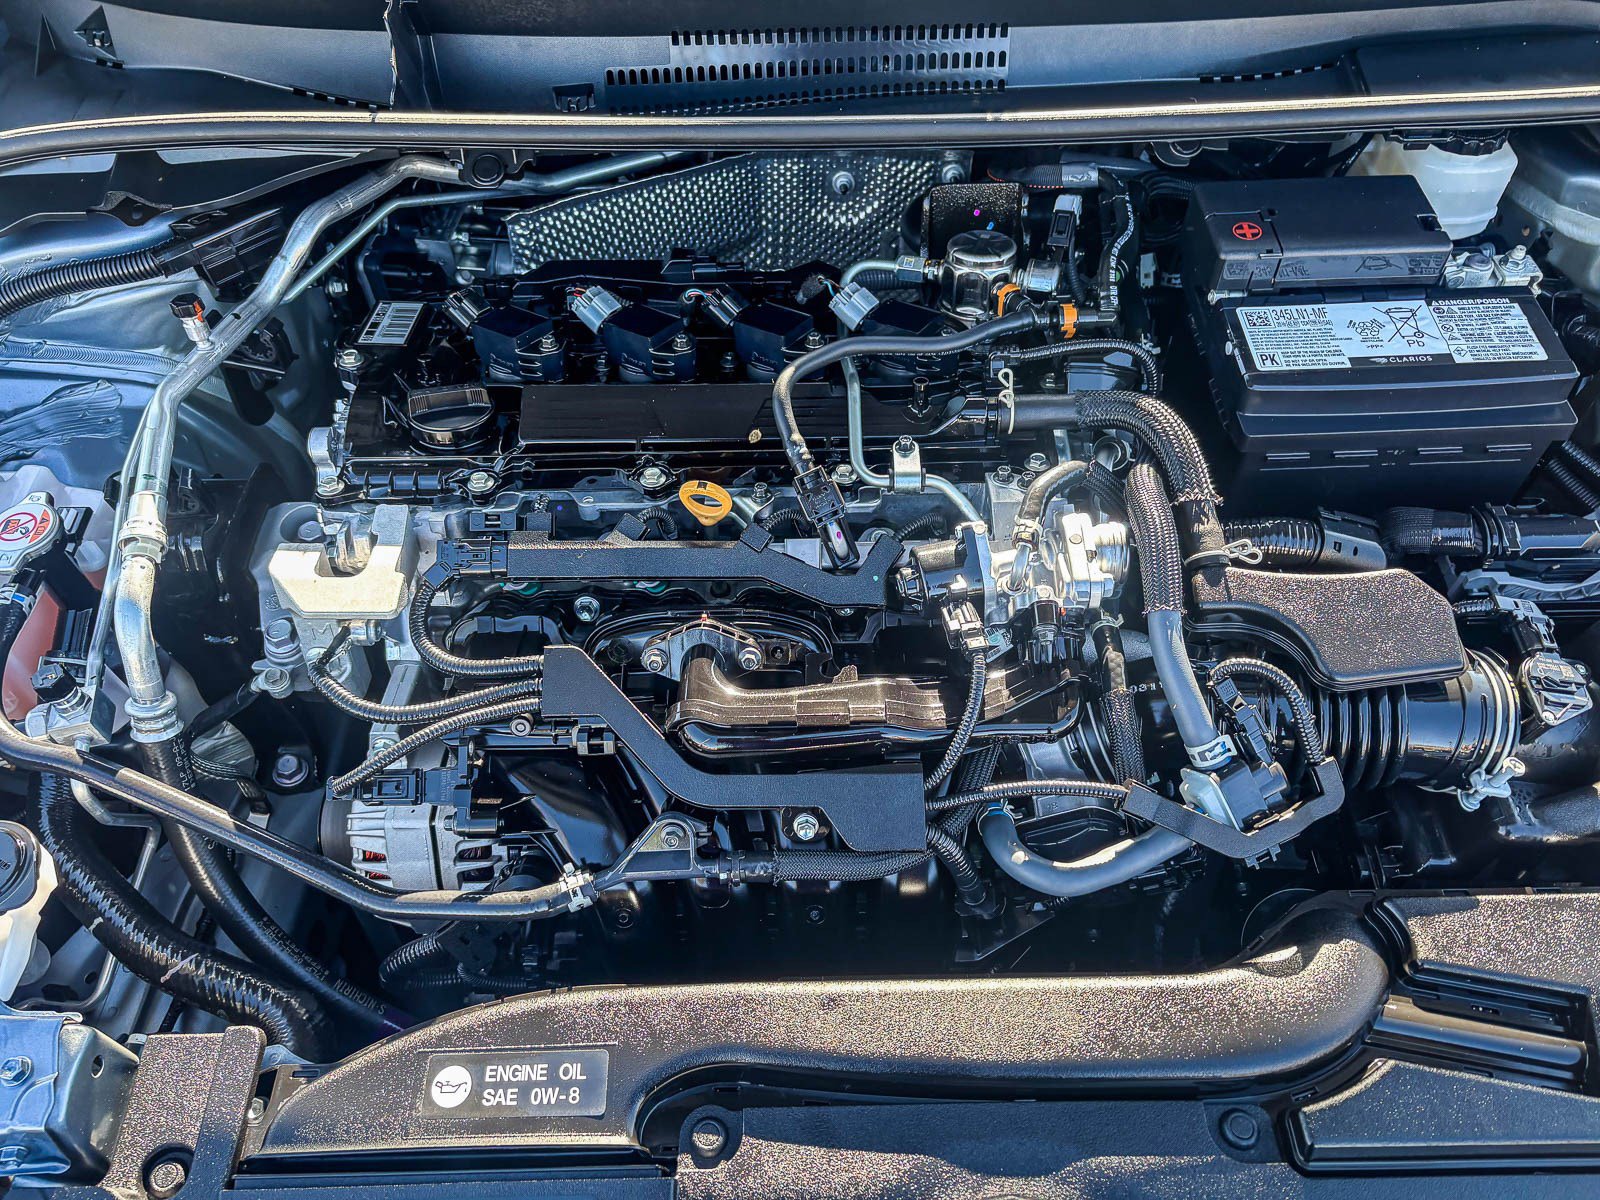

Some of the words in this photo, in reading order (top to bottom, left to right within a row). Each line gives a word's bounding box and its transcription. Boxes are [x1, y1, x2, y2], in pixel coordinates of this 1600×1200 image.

[1439, 298, 1510, 306] DANGER/POISON
[1272, 307, 1328, 320] 345LN1-MF
[1406, 339, 1425, 347] Pb
[1260, 353, 1280, 366] PK
[1389, 355, 1433, 363] CLARIOS
[484, 1064, 549, 1083] ENGINE
[559, 1063, 587, 1080] OIL
[481, 1088, 519, 1107] SAE
[530, 1087, 581, 1105] 0W-8
